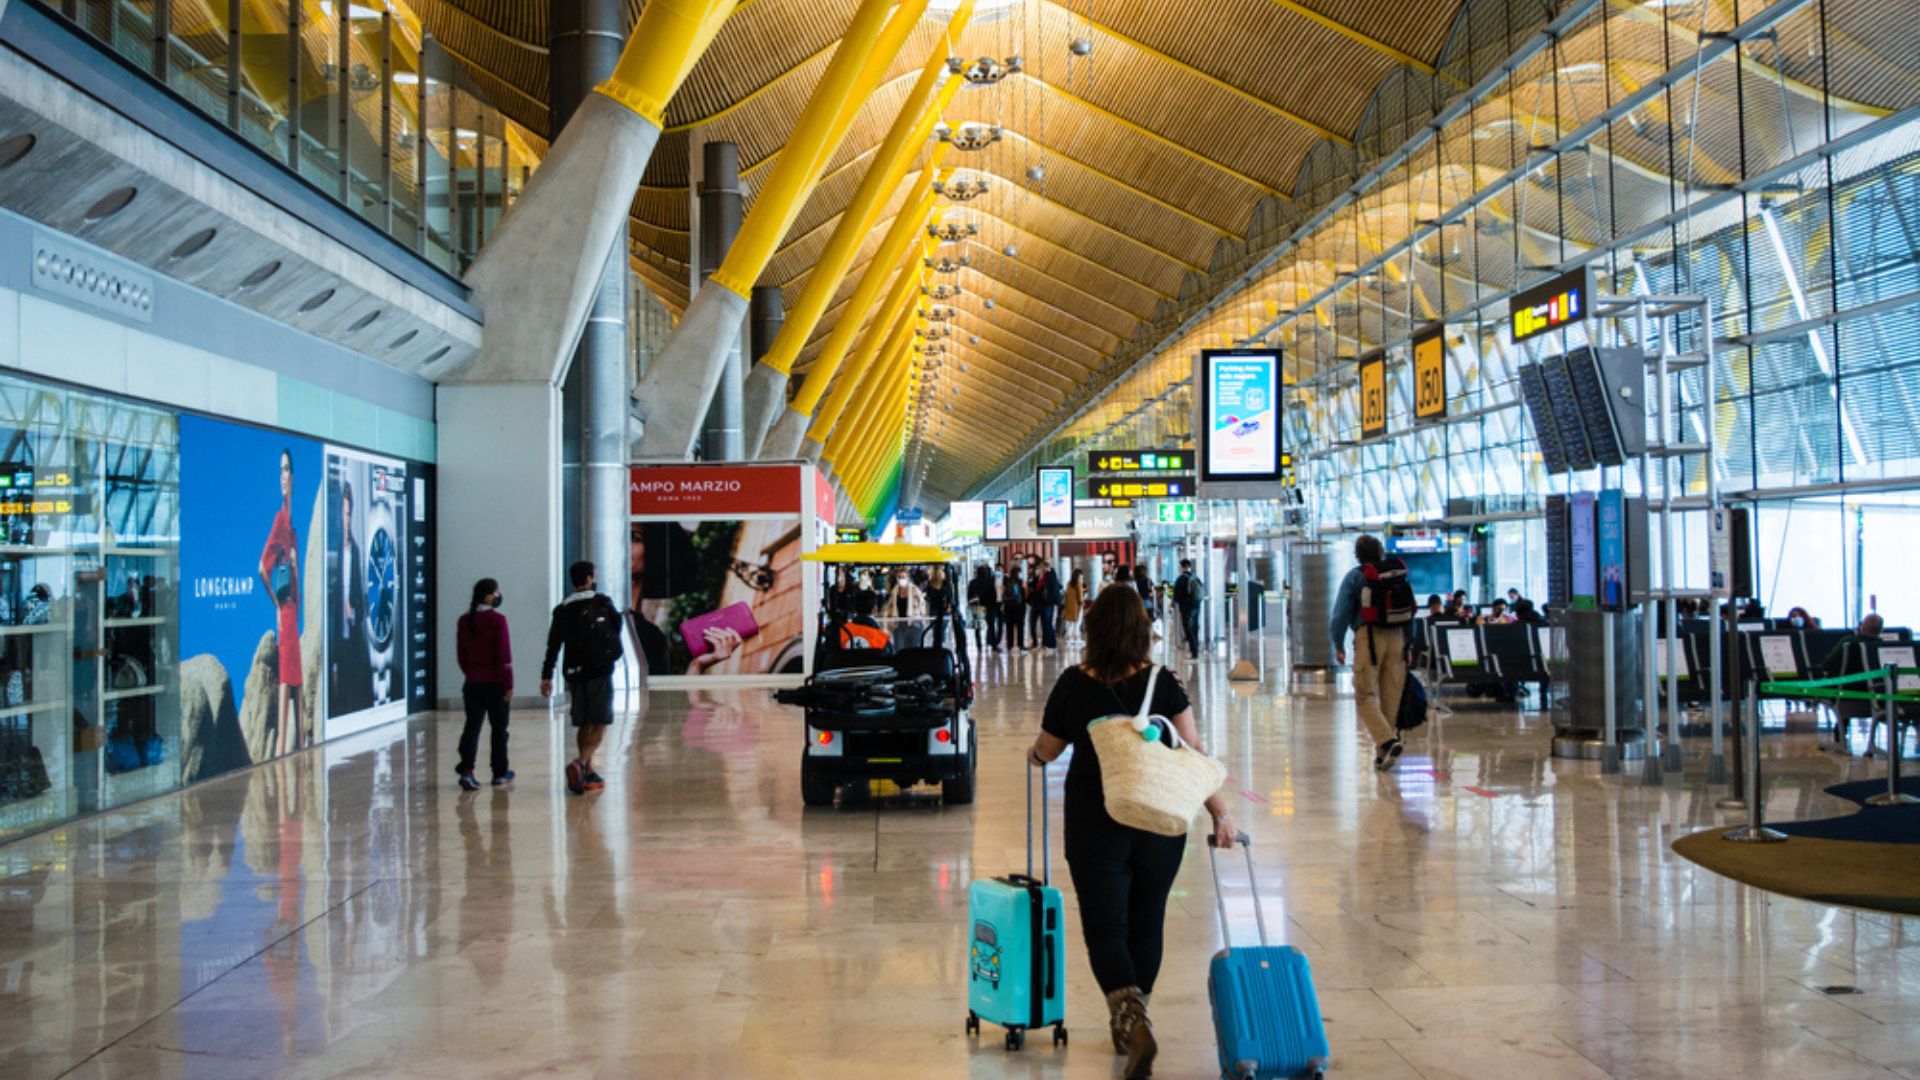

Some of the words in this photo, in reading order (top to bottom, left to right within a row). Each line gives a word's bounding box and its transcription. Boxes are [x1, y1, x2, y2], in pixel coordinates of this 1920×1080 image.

[1419, 366, 1440, 409] J50
[1364, 387, 1382, 425] J51
[630, 481, 675, 493] AMPO
[680, 480, 741, 492] MARZIO
[195, 576, 254, 597] LONGCHAMP
